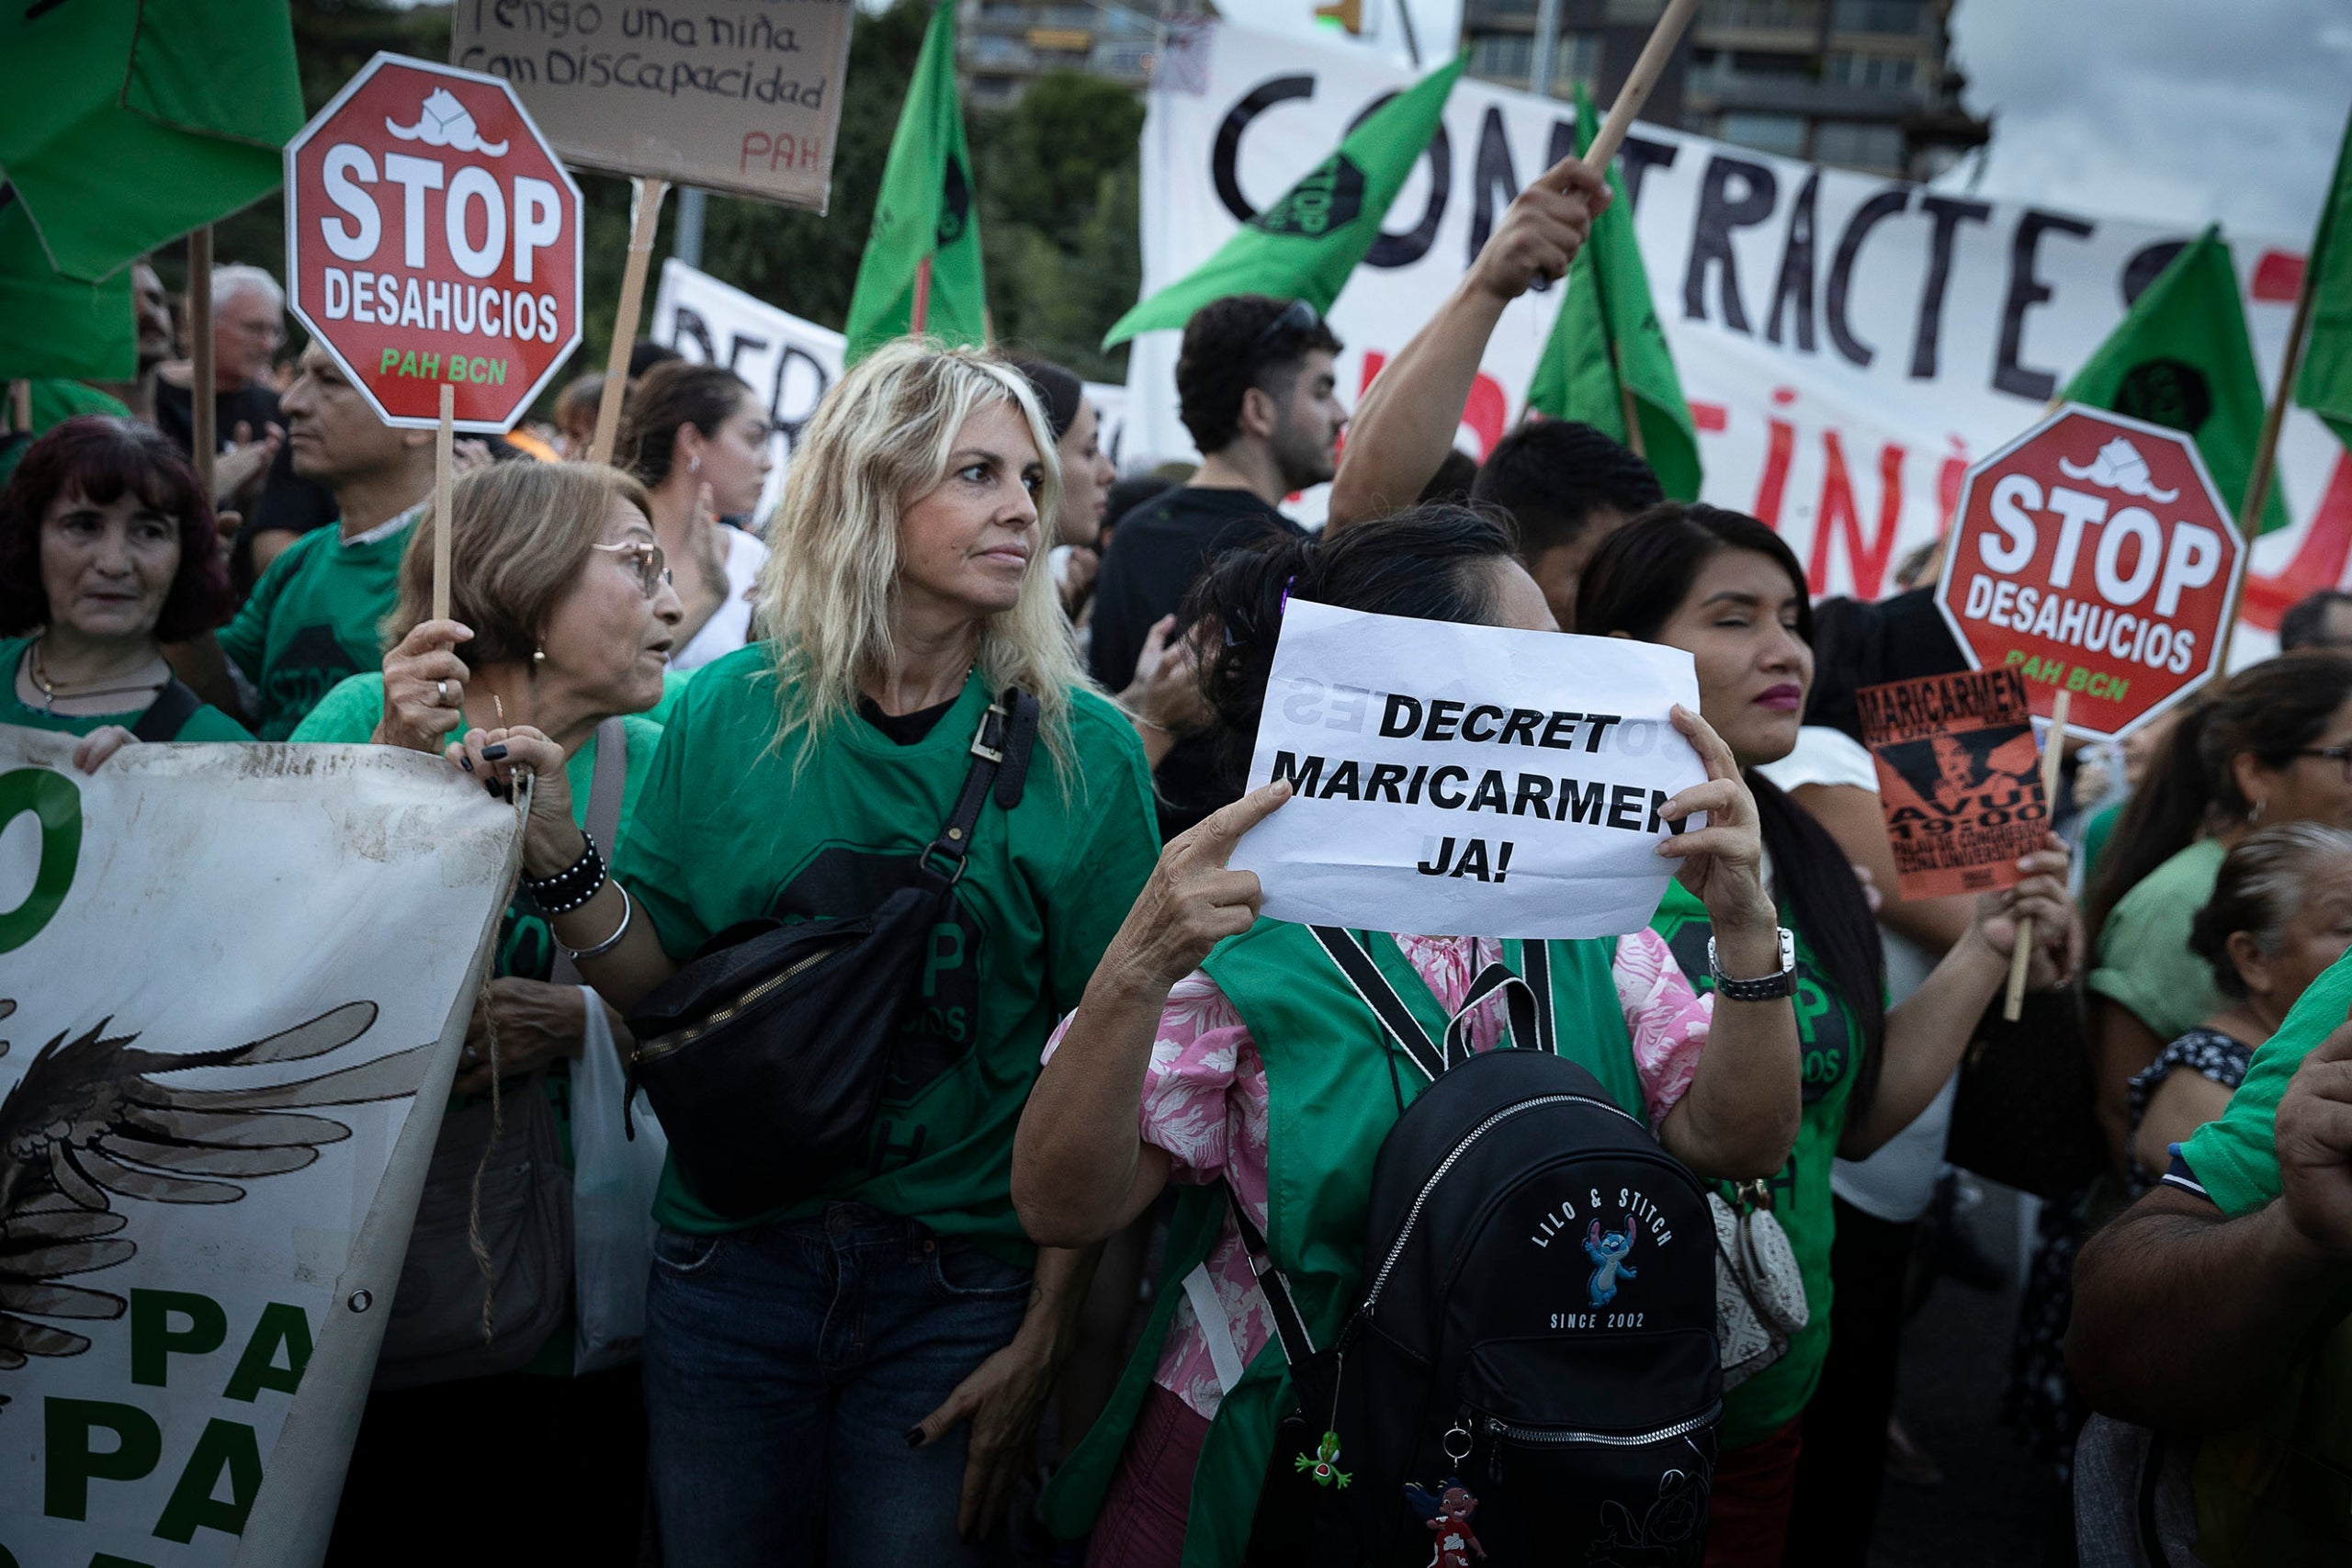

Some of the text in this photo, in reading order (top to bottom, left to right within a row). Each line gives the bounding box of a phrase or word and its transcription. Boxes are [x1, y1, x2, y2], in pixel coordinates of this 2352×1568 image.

[623, 9, 697, 48] una
[740, 130, 820, 174] PAH
[321, 142, 562, 284] STOP
[324, 266, 559, 344] DESAHUCIOS
[379, 348, 509, 386] PAH BCN
[1979, 473, 2222, 618] STOP
[1964, 575, 2196, 674] DESAHUCIOS
[1857, 667, 2029, 728] MARICARMEN
[2006, 650, 2131, 703] PAH BCN
[1379, 694, 1622, 753] DECRET
[1271, 750, 1690, 836] MARICARMEN
[1889, 787, 2044, 823] AVUI
[1889, 804, 2047, 839] 19:00
[1417, 836, 1514, 884] JA!
[1532, 1188, 1673, 1248] LILO & STITCH
[1550, 1313, 1645, 1329] SINCE 2002
